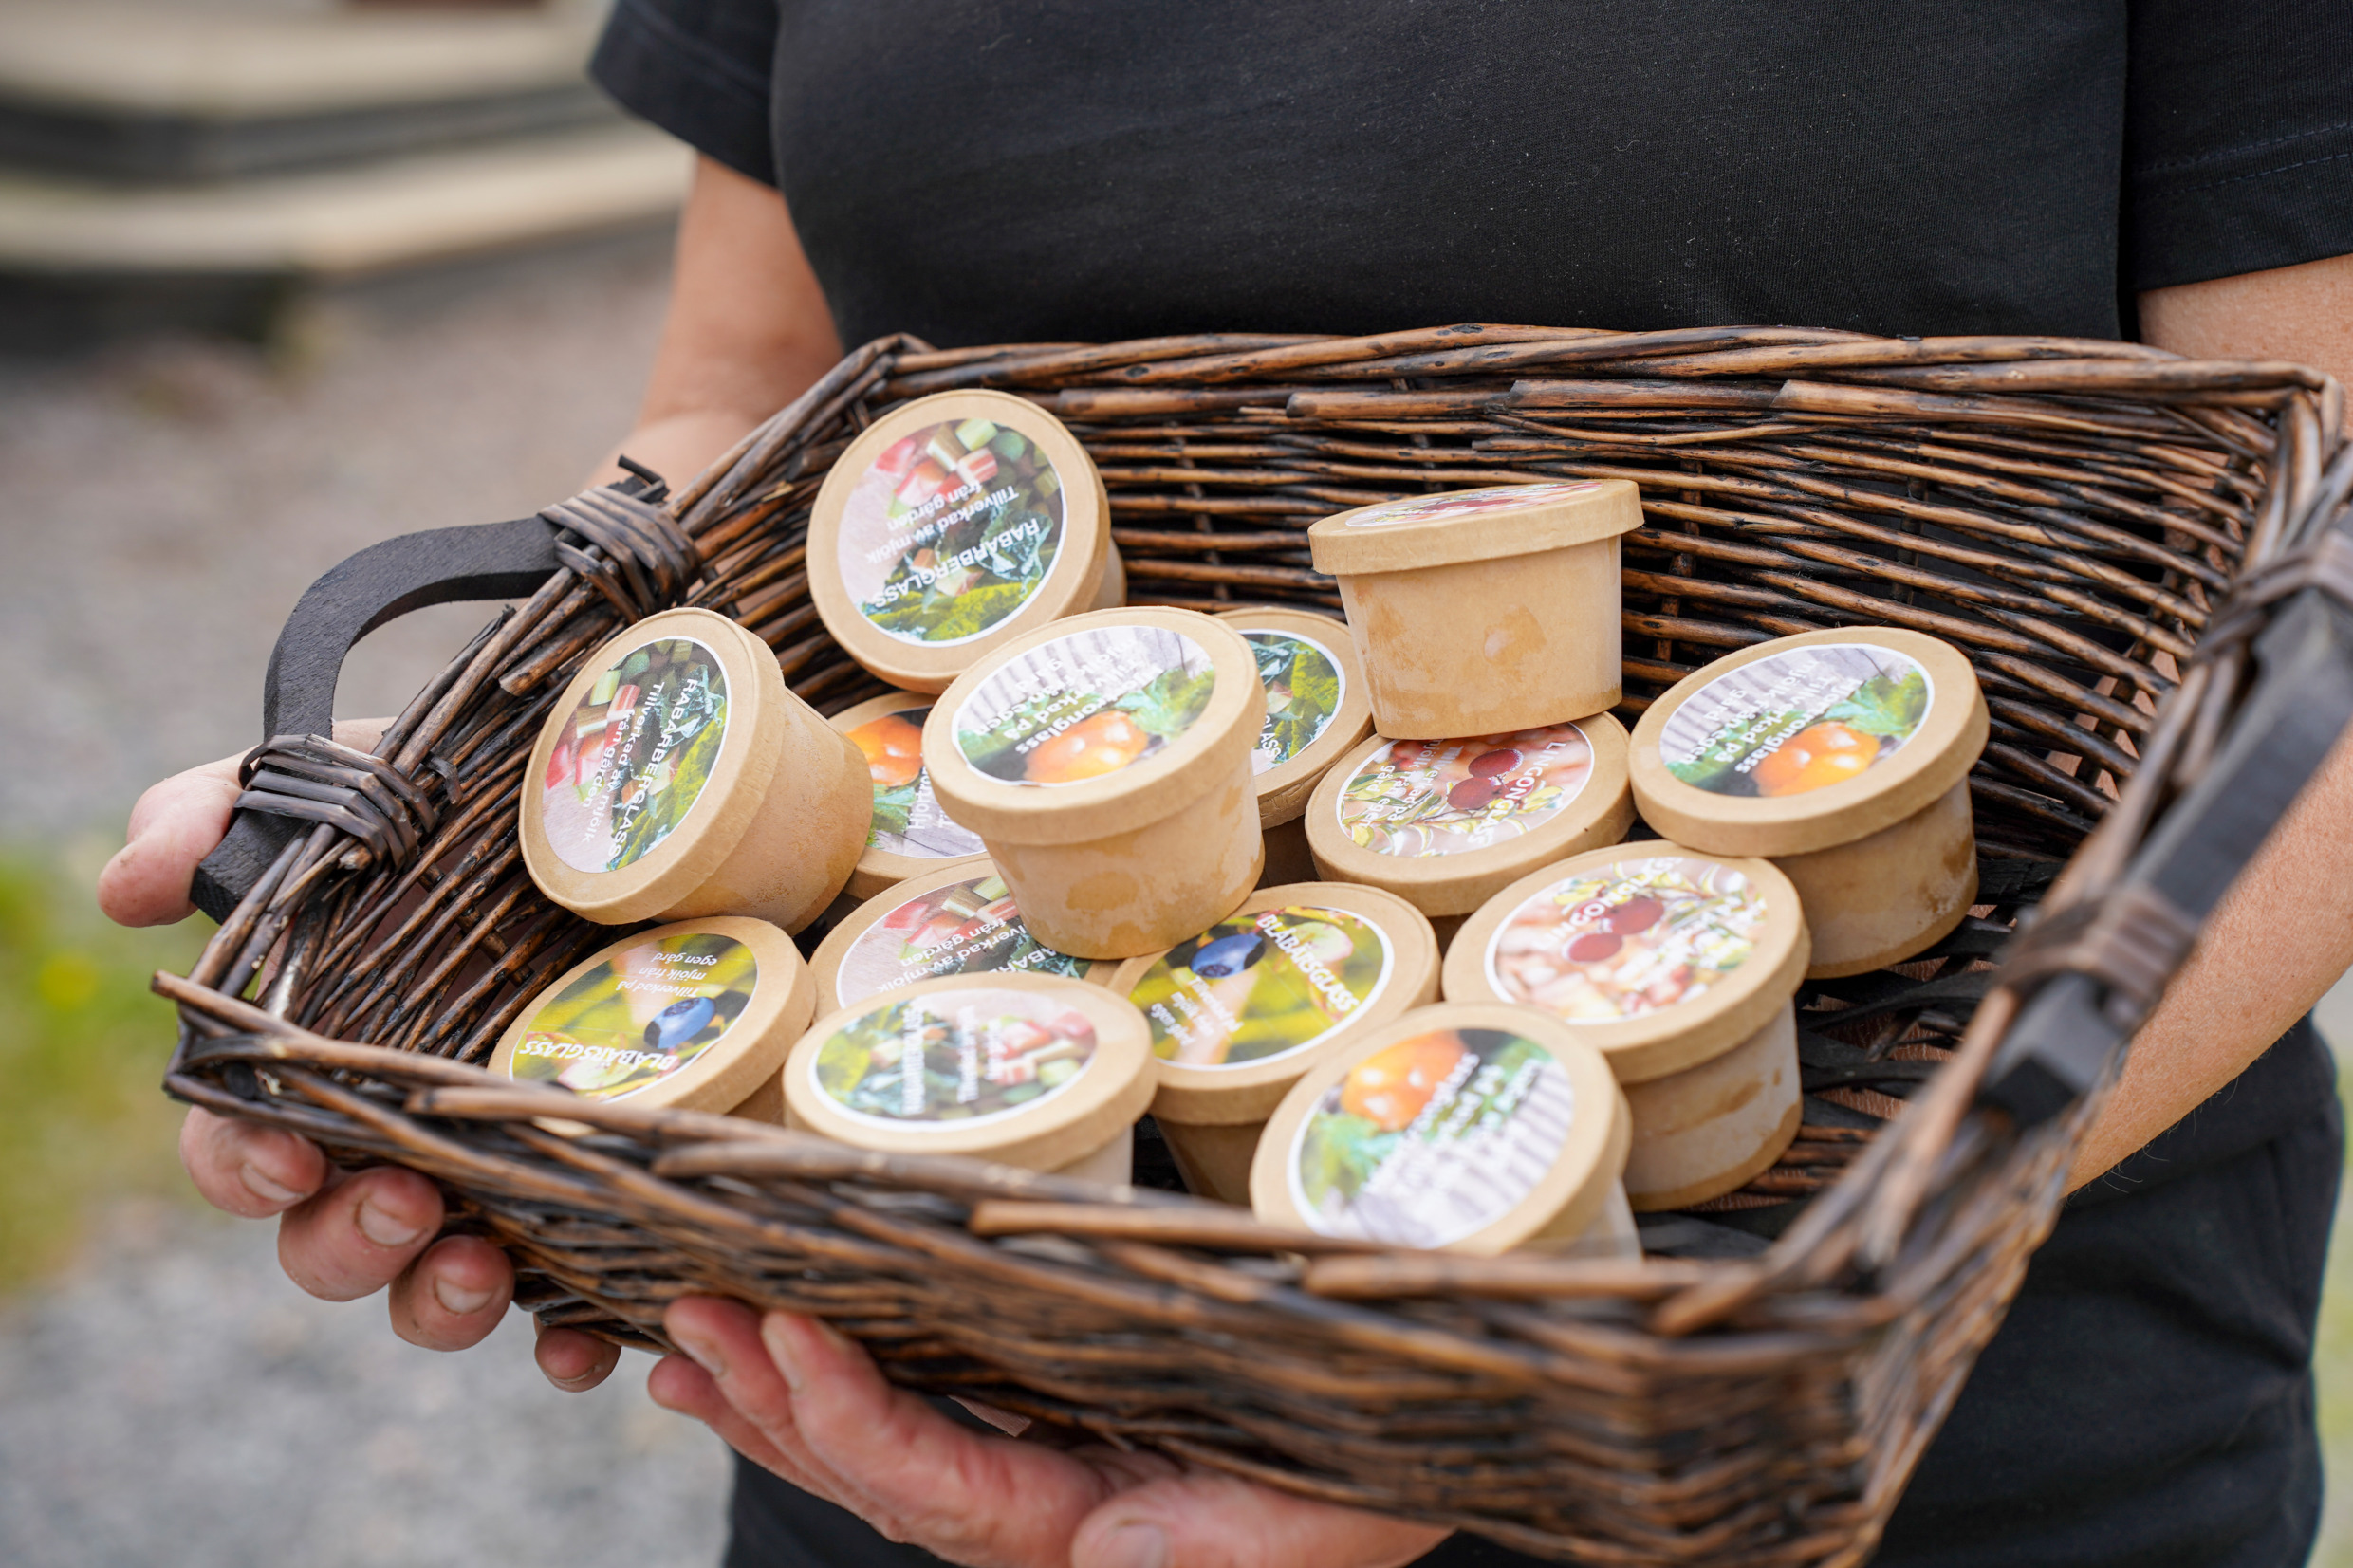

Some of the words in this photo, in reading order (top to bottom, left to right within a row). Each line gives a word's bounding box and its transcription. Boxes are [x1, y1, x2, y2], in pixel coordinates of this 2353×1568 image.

[947, 481, 982, 504] från
[887, 494, 945, 531] gården
[936, 486, 1018, 533] Tillverkad
[865, 532, 912, 564] mjölk
[913, 525, 935, 542] av
[875, 519, 1039, 607] RABARBERGLASS
[1028, 675, 1073, 704] från
[1767, 659, 1818, 698] mjölk
[975, 703, 1027, 736] egen
[1705, 688, 1744, 720] gård
[1729, 697, 1767, 729] från
[1743, 676, 1828, 744] Tillverkad
[613, 710, 635, 741] från
[617, 684, 665, 763] Tillverkad
[1004, 719, 1032, 740] på
[1735, 677, 1861, 773] Hjortronglass
[1682, 729, 1725, 764] egen
[1714, 738, 1735, 763] på
[584, 749, 615, 807] gården
[607, 771, 621, 790] av
[608, 680, 698, 856] RABARBERGLASS
[1365, 766, 1394, 793] gård
[1470, 742, 1566, 843] LINGONGLASS
[582, 795, 608, 841] mjölk
[1361, 798, 1389, 828] egen
[1388, 804, 1407, 820] på
[955, 921, 1028, 962] lverkad
[969, 917, 1006, 939] från
[652, 951, 684, 962] gård
[685, 954, 717, 965] egen
[901, 933, 963, 967] gården
[929, 955, 953, 970] av
[1257, 914, 1360, 1012] BLÅBÄRSGLASS
[616, 980, 633, 990] på
[639, 967, 666, 977] från
[667, 968, 707, 979] mjölk
[877, 966, 927, 993] mjölk
[634, 983, 698, 997] Tillverkad
[519, 1042, 677, 1070] BLÅBÄRSGLASS
